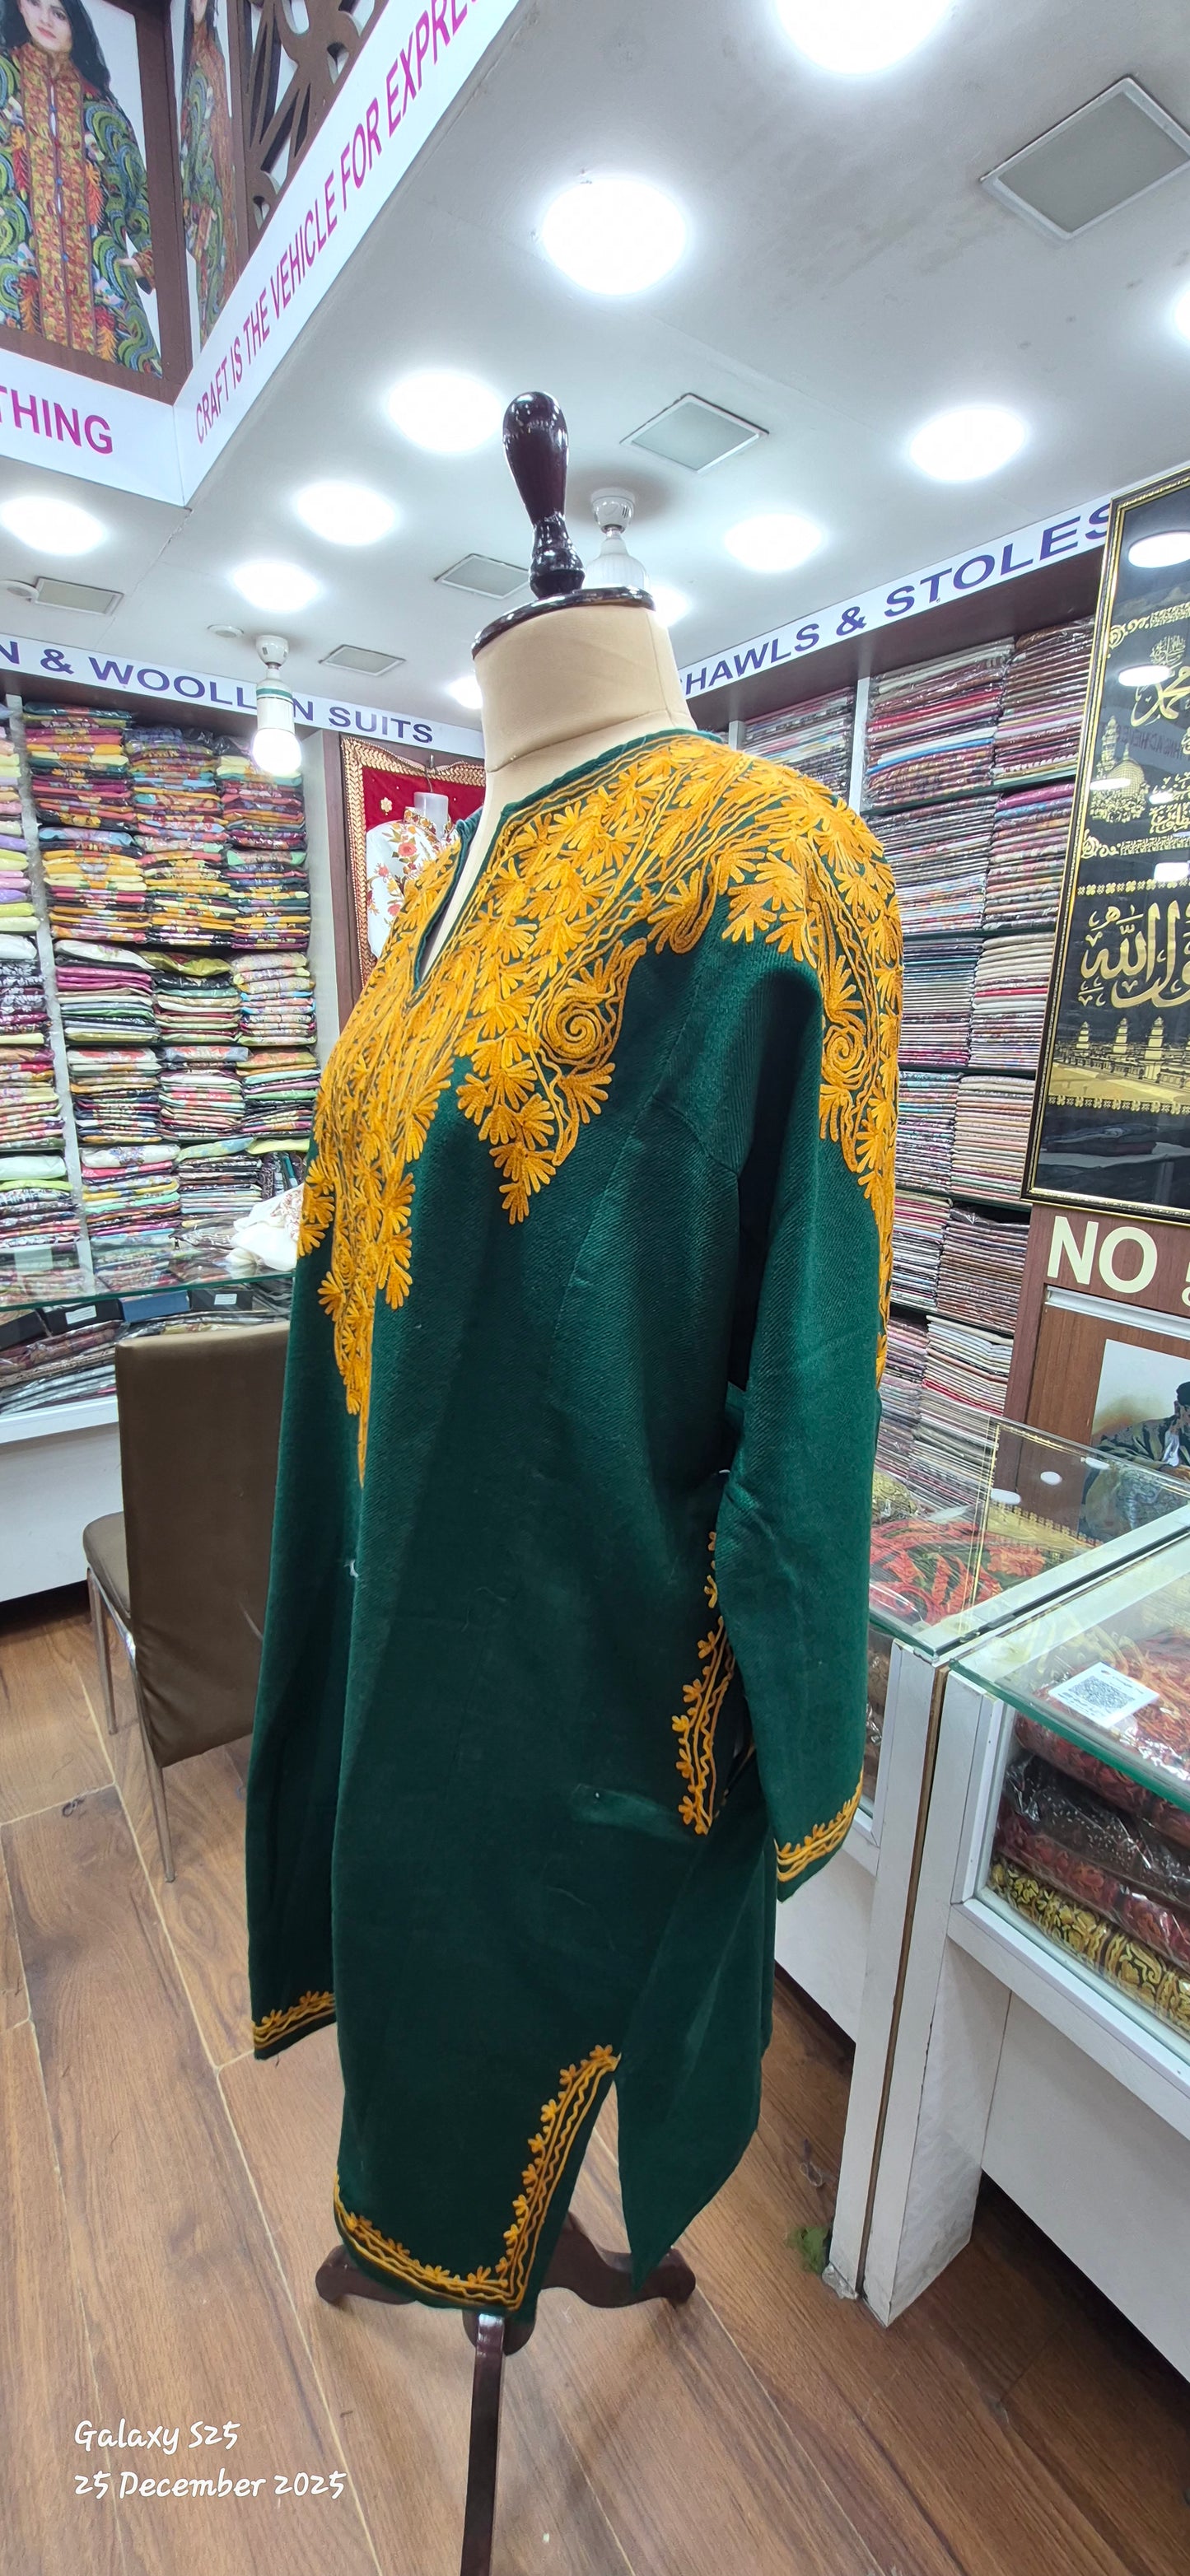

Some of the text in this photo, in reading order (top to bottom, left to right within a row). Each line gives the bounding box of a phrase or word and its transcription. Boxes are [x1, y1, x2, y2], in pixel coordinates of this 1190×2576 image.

[196, 0, 478, 444] CRAFT IS THE VEHICLE FOR EXPR
[679, 503, 1112, 696] HAWLS & STOLES
[40, 648, 75, 675] &
[88, 656, 314, 722] WOOLLN
[328, 706, 433, 744] SUITS
[1047, 1216, 1158, 1294] NO
